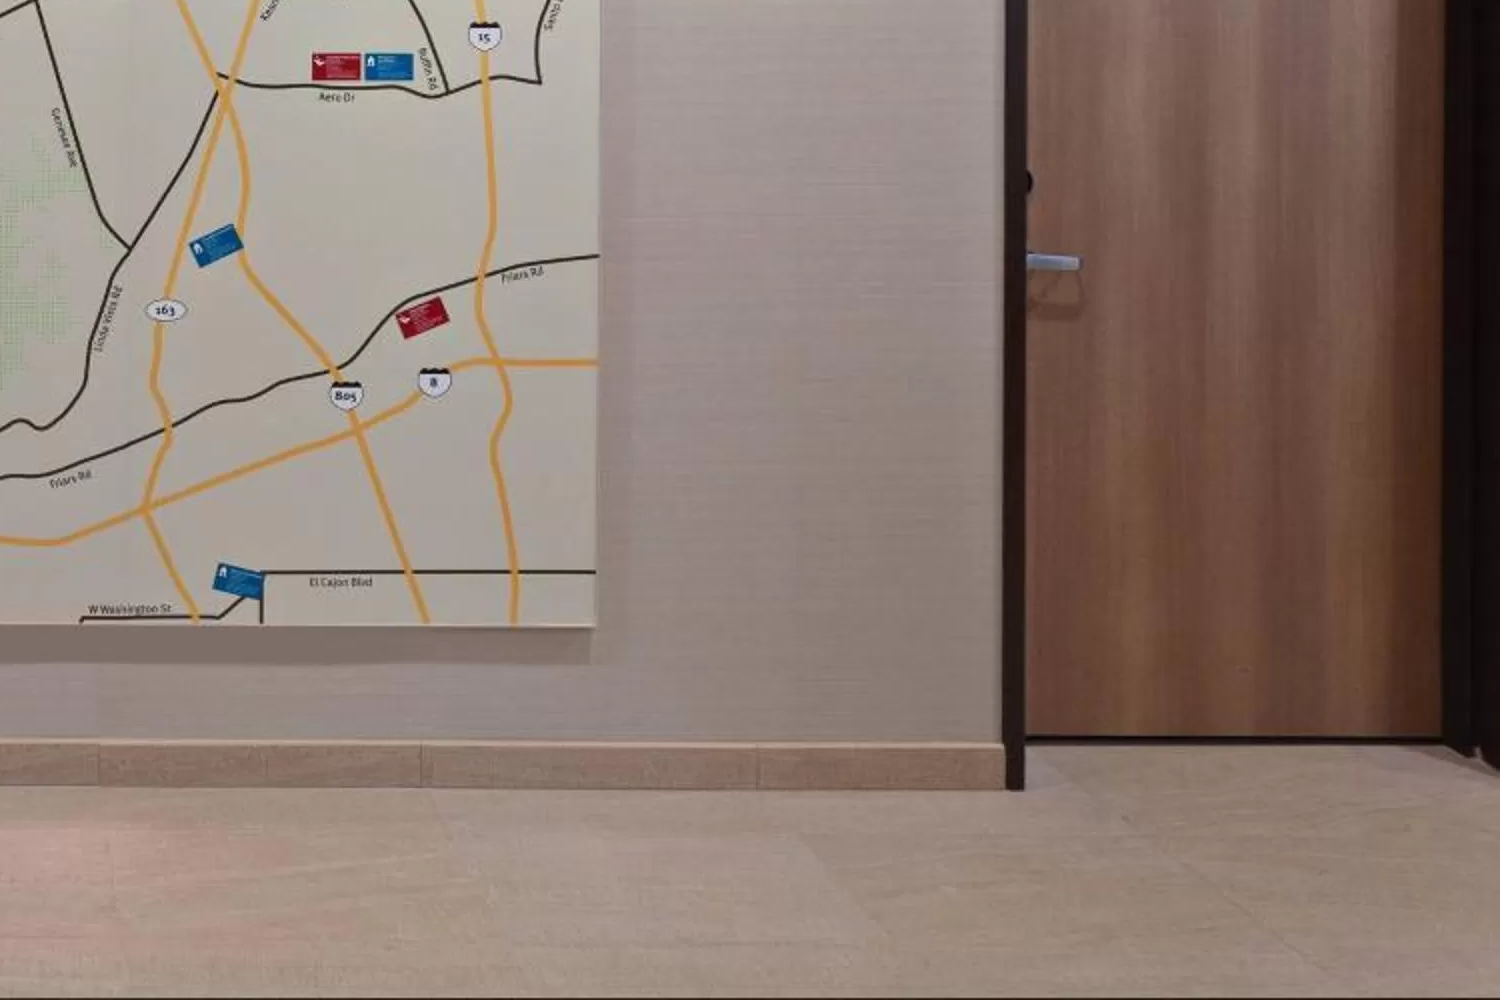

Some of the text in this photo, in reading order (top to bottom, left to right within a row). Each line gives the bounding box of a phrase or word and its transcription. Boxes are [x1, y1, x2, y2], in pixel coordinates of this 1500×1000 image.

[477, 33, 492, 43] 15
[155, 304, 176, 317] 163
[335, 390, 357, 402] 805
[320, 577, 349, 590] Cajon
[351, 577, 373, 588] Blvd
